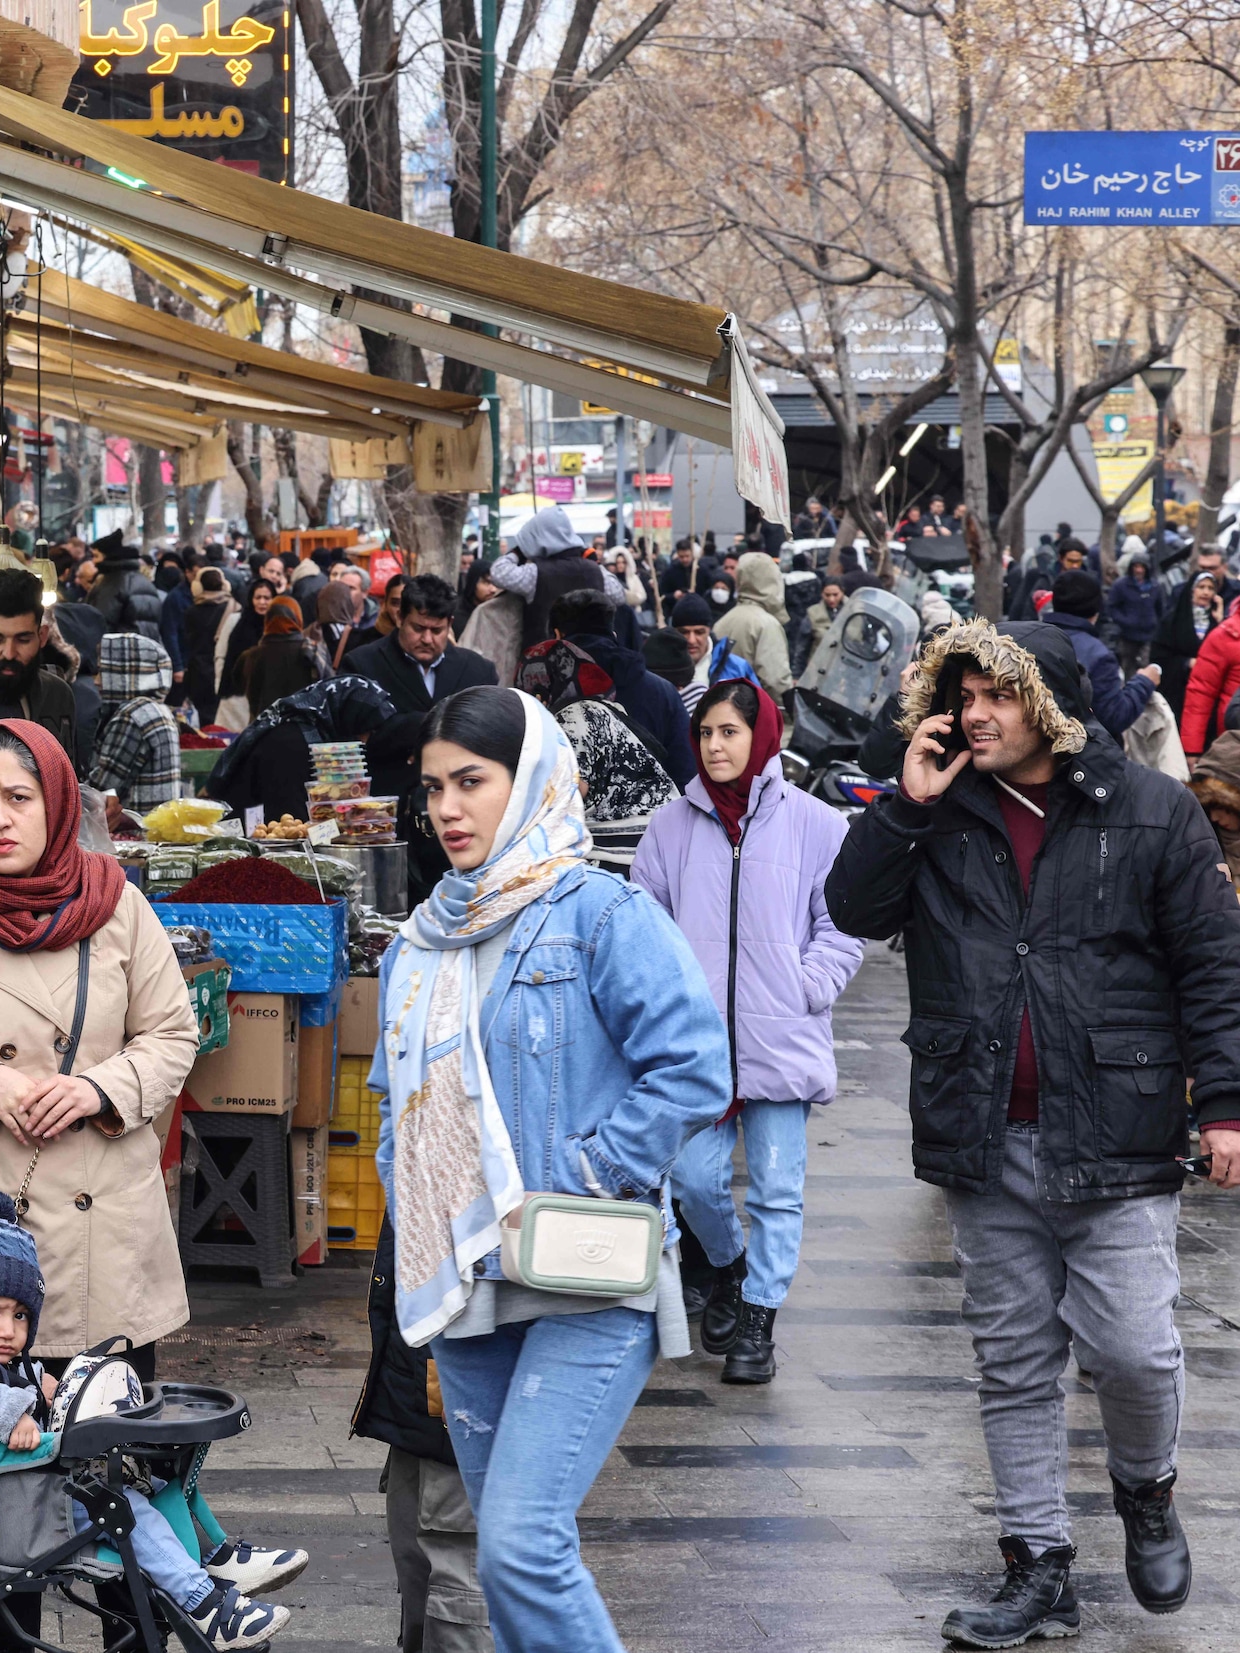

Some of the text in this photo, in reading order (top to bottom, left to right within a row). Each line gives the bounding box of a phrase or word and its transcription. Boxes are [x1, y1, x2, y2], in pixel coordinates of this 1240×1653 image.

[92, 81, 245, 138] مسل
[1180, 136, 1212, 152] کوچه
[1041, 162, 1202, 195] حاج رحیم خان
[1037, 207, 1201, 218] HAJ RAHIM KHAN ALLEY
[246, 1009, 279, 1018] IFFCO
[226, 1097, 277, 1106] PRO ICM25
